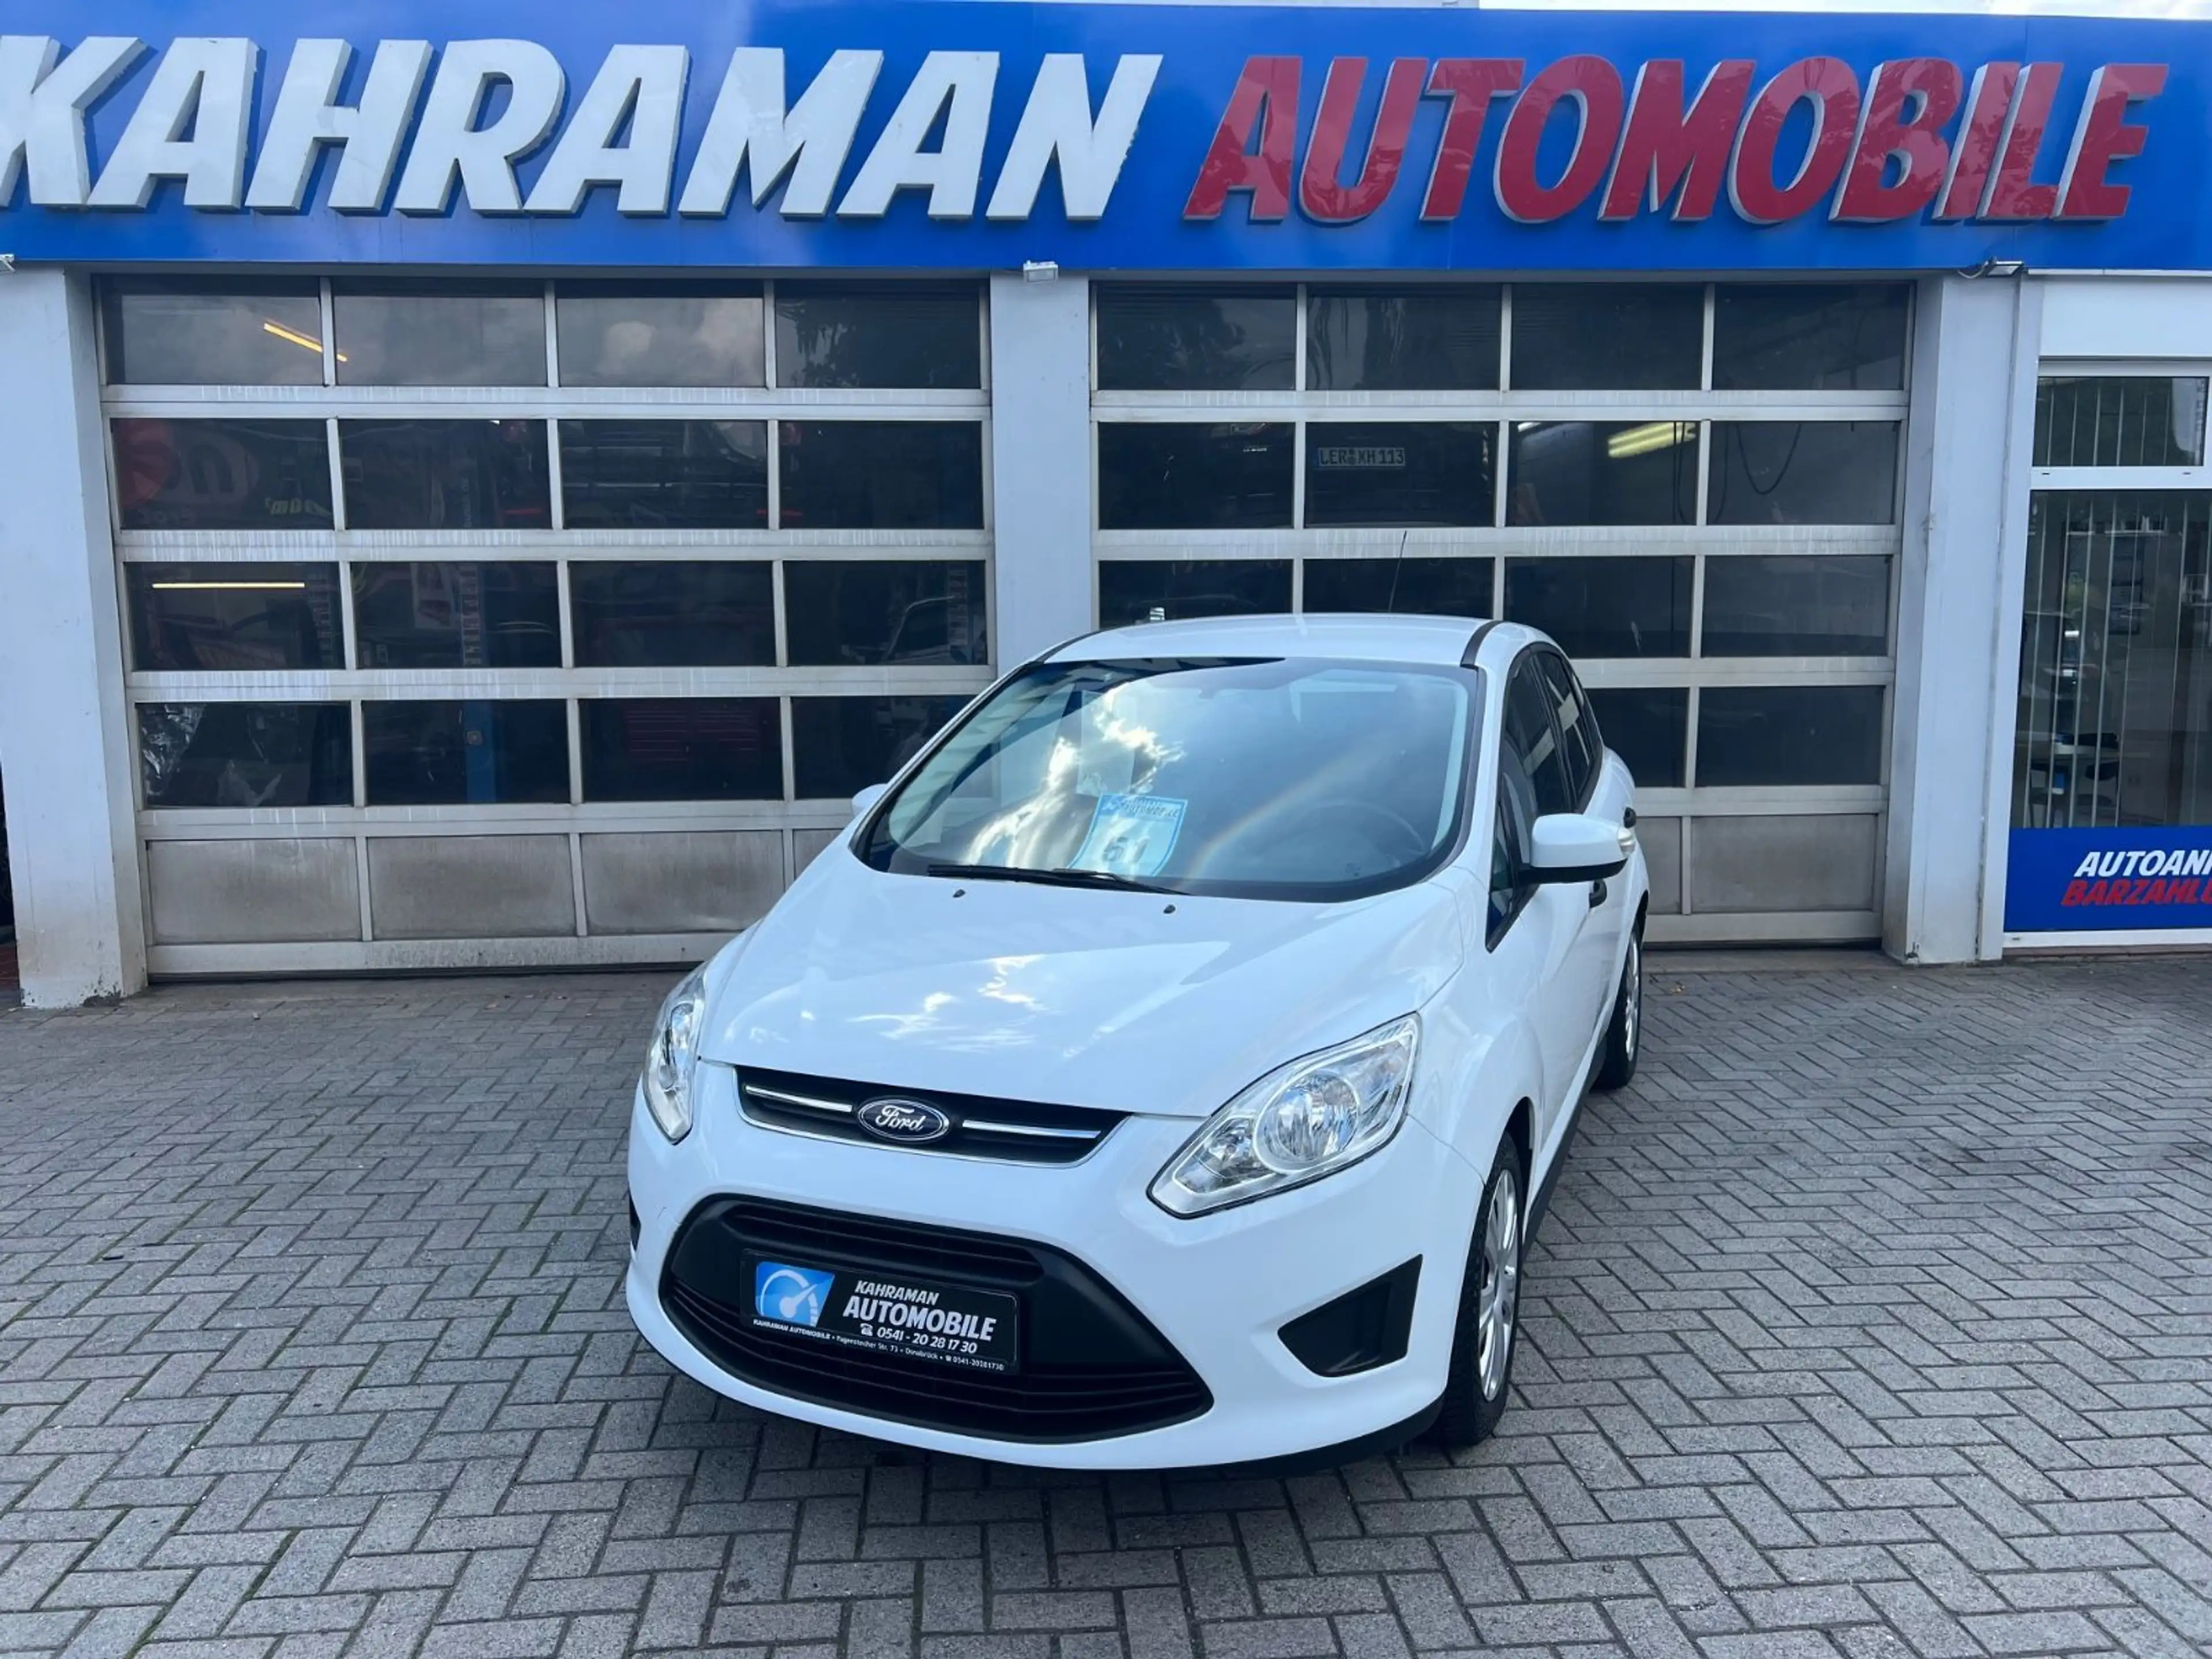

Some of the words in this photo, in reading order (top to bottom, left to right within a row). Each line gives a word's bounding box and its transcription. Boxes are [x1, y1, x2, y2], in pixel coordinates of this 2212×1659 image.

[0, 35, 1163, 221] KAHRAMAN
[1183, 55, 2168, 222] AUTOMOBILE
[1320, 449, 1347, 464] LER
[1378, 449, 1404, 464] 113
[875, 1105, 926, 1131] Ford
[855, 1280, 940, 1306] KAHRAMAN
[843, 1296, 997, 1341] AUTOMOBILE
[789, 1325, 831, 1339] AUTOMOBILE
[877, 1327, 904, 1342] 0541
[912, 1332, 929, 1345] 20
[929, 1336, 946, 1349] 28
[948, 1339, 960, 1350] 17
[960, 1341, 978, 1354] 30
